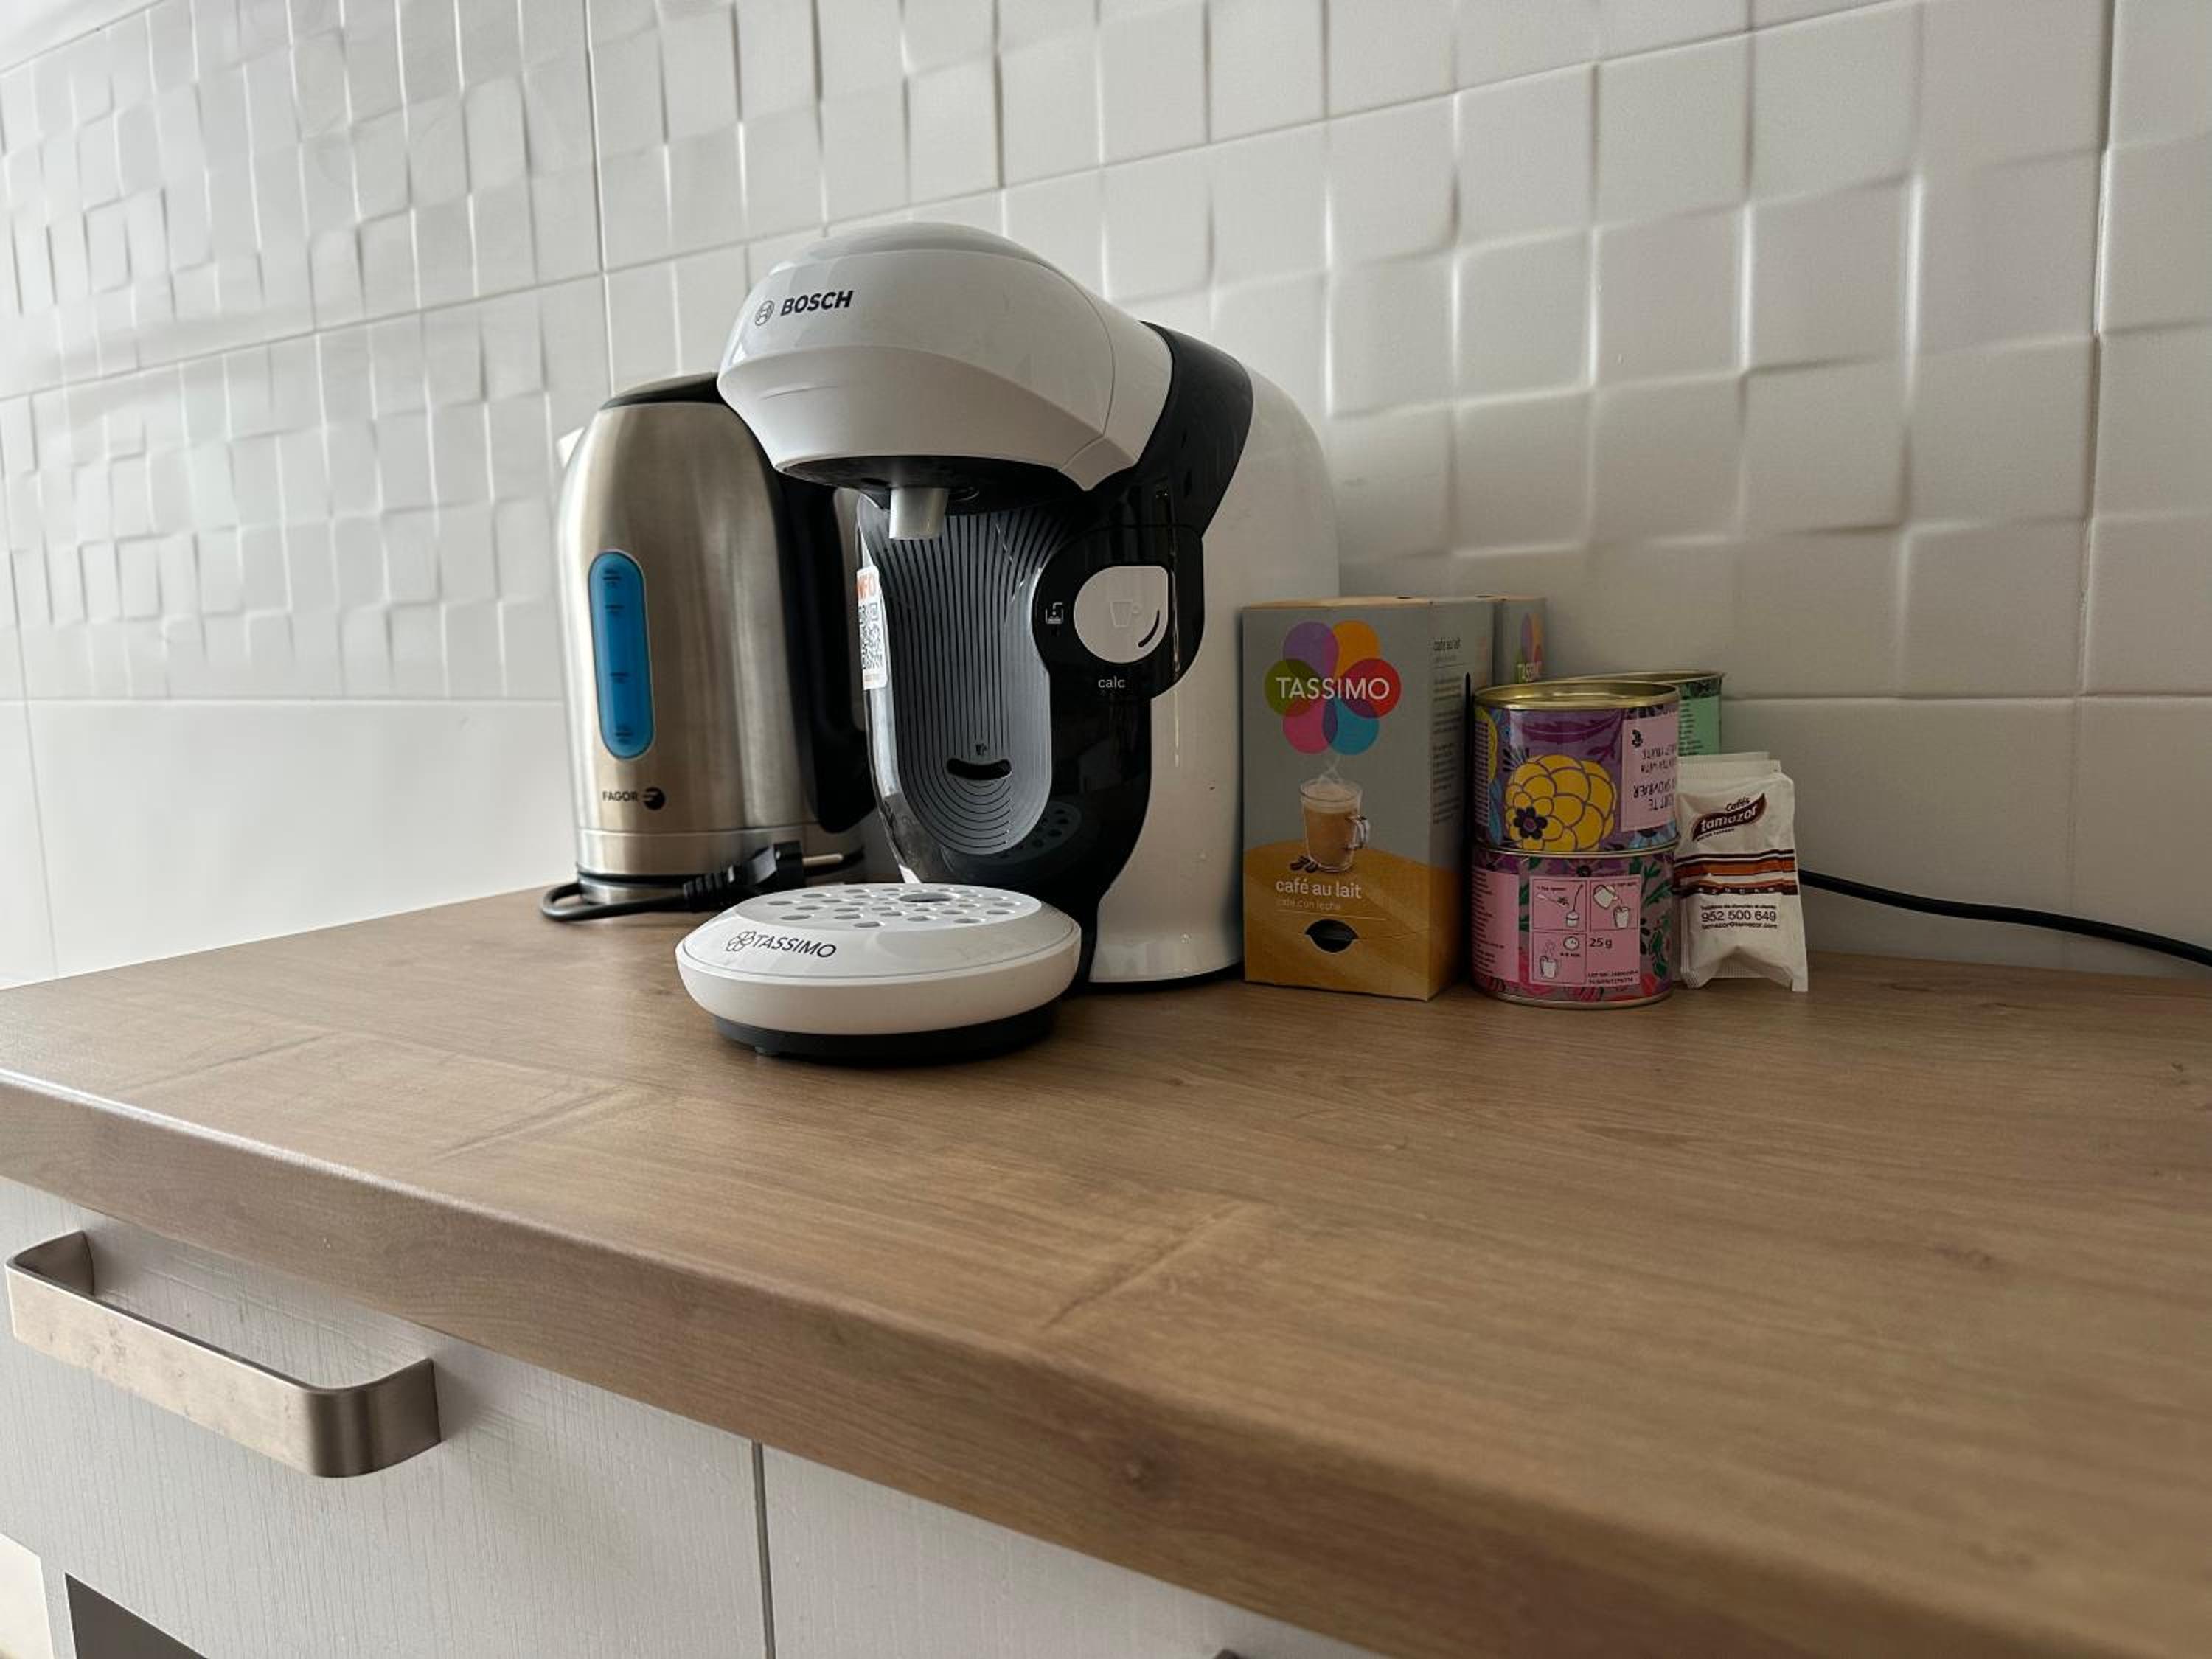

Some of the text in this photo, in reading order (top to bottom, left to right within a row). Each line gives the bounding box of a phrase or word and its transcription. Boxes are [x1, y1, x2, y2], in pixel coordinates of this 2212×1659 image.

[780, 291, 854, 316] BOSCH
[1098, 675, 1126, 689] calc
[1276, 677, 1390, 700] TASSIMO
[602, 790, 638, 802] FAGOR
[1700, 804, 1759, 832] tamazor
[1276, 877, 1362, 899] café au lait
[1701, 909, 1776, 922] 952 500 649
[753, 934, 837, 958] TASSIMO
[1589, 937, 1613, 949] 25 g
